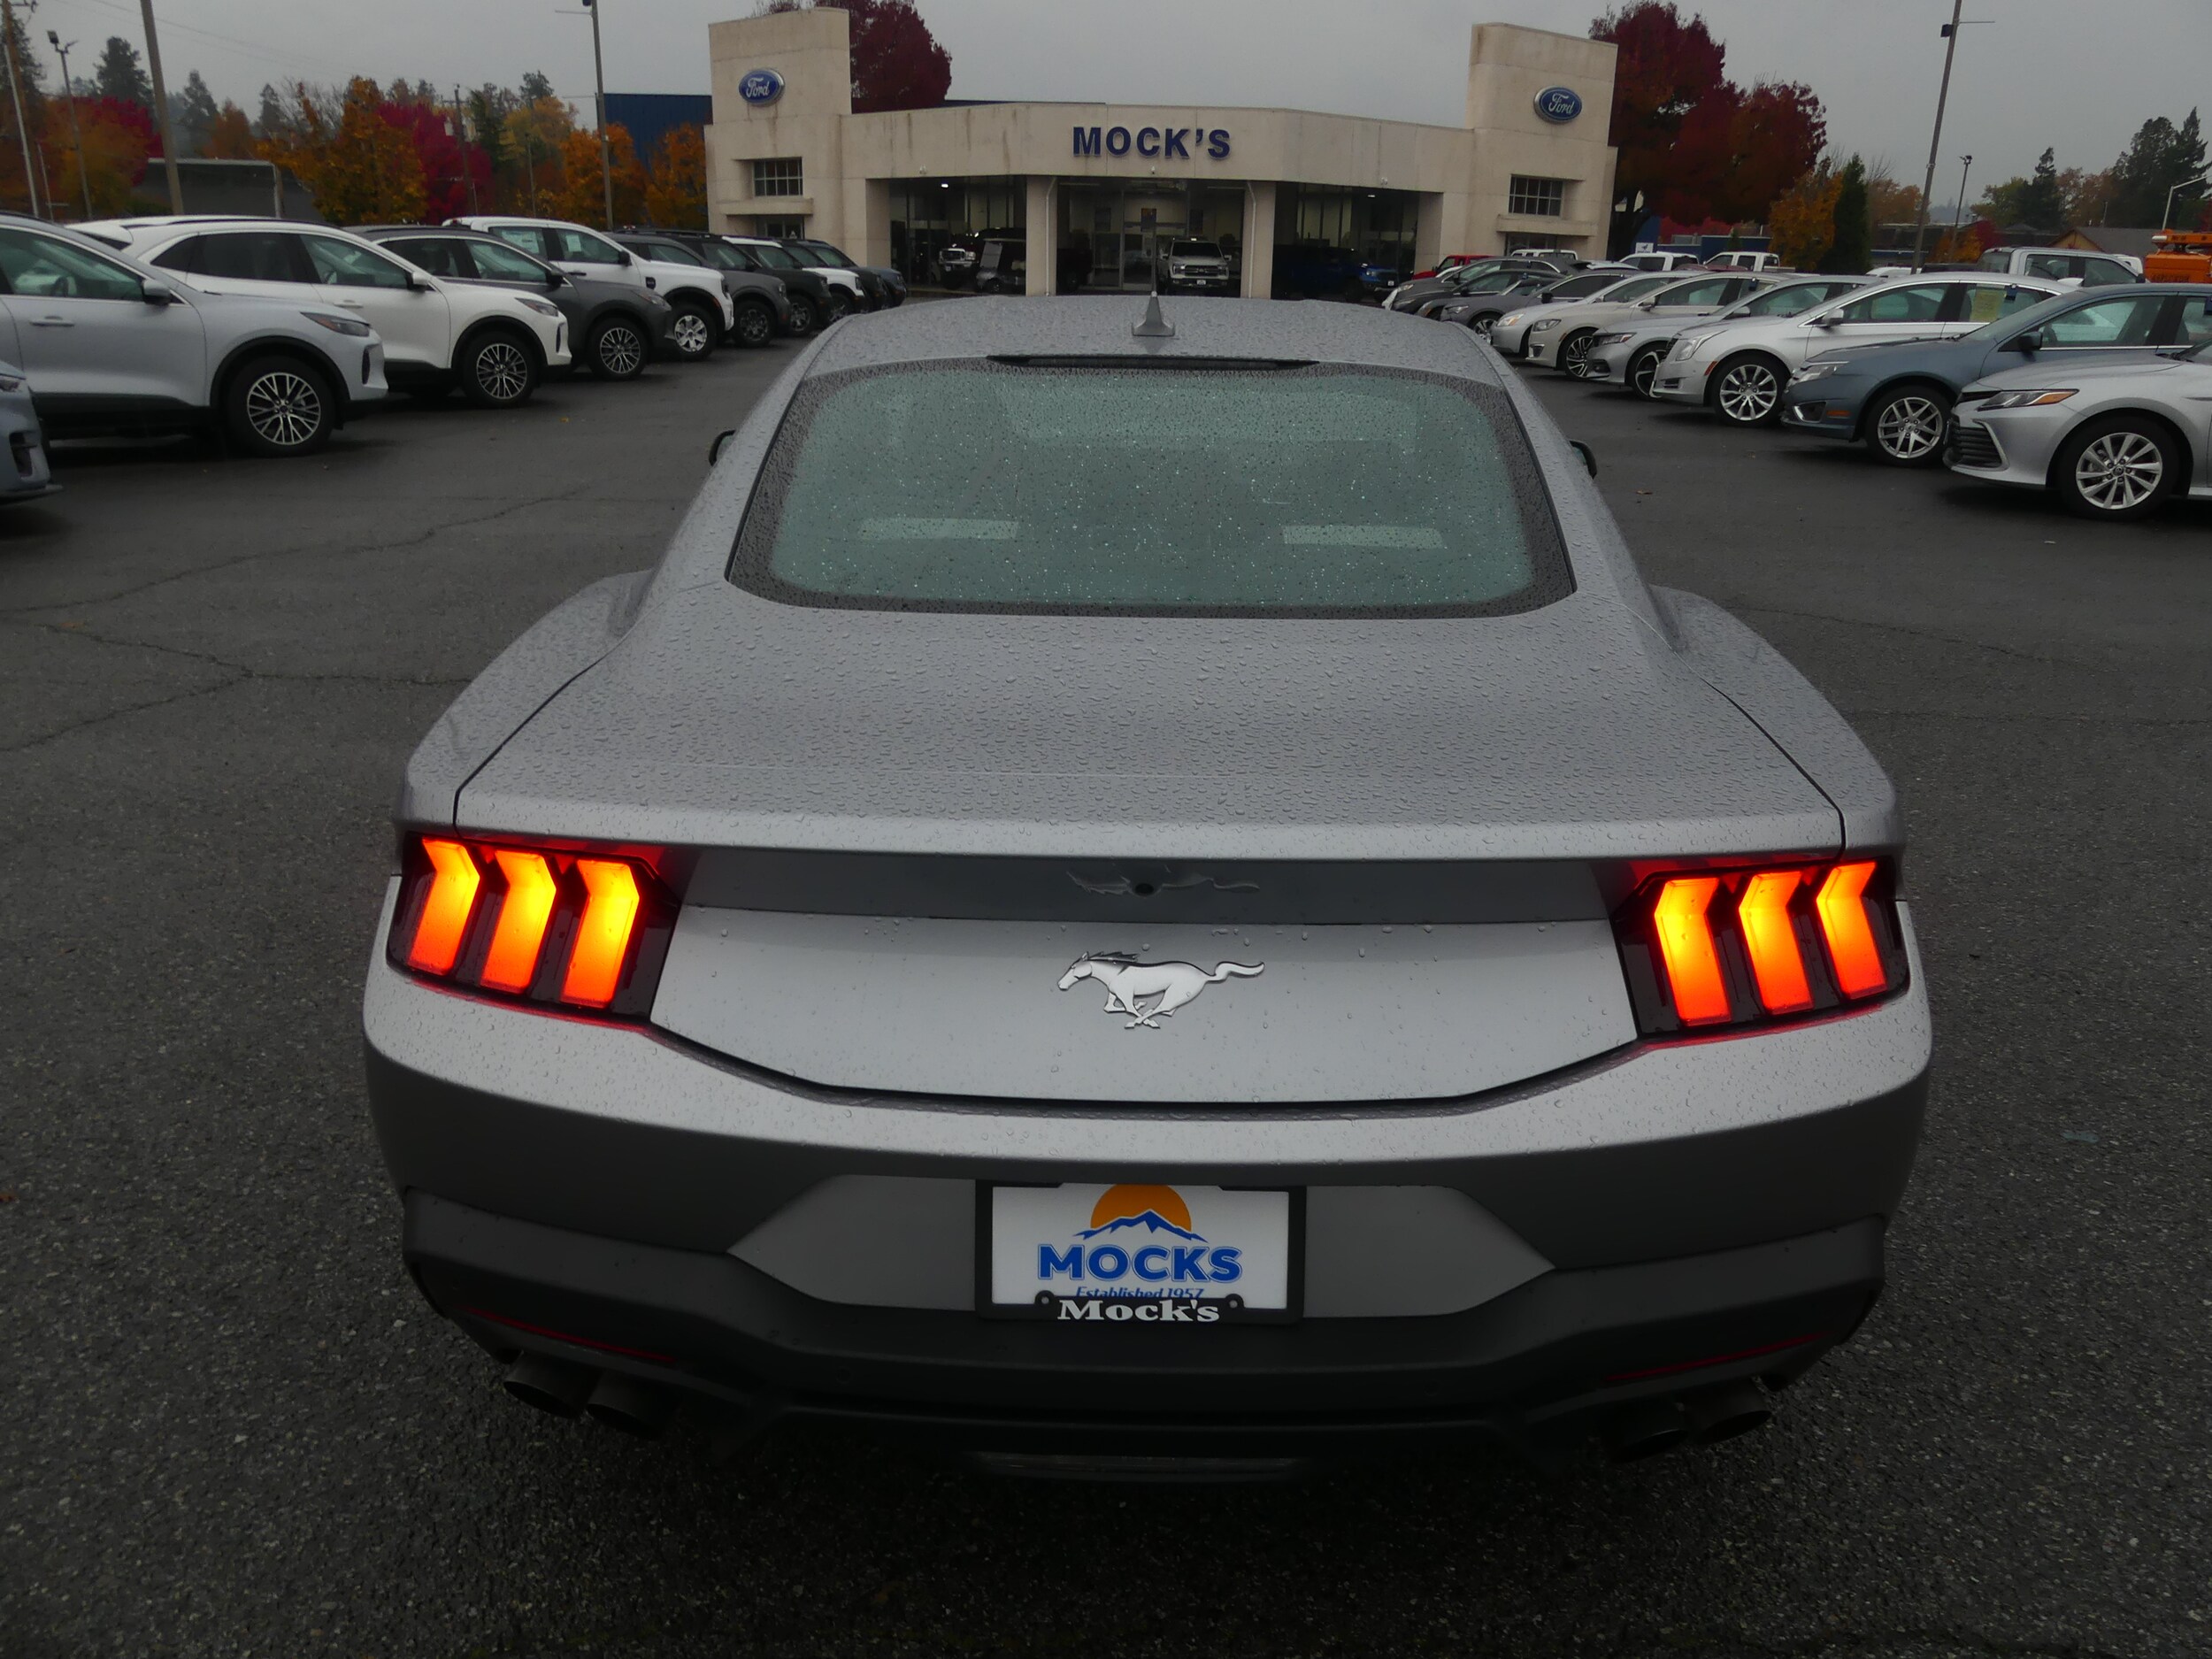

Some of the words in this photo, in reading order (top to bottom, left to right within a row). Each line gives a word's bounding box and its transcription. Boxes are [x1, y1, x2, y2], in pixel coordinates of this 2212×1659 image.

[746, 77, 770, 97] Ford
[1548, 92, 1575, 114] Ford
[1072, 126, 1231, 160] MOCK'S
[1037, 1244, 1243, 1283] MOCKS
[1076, 1286, 1164, 1298] Established
[1057, 1299, 1220, 1322] Mock's
